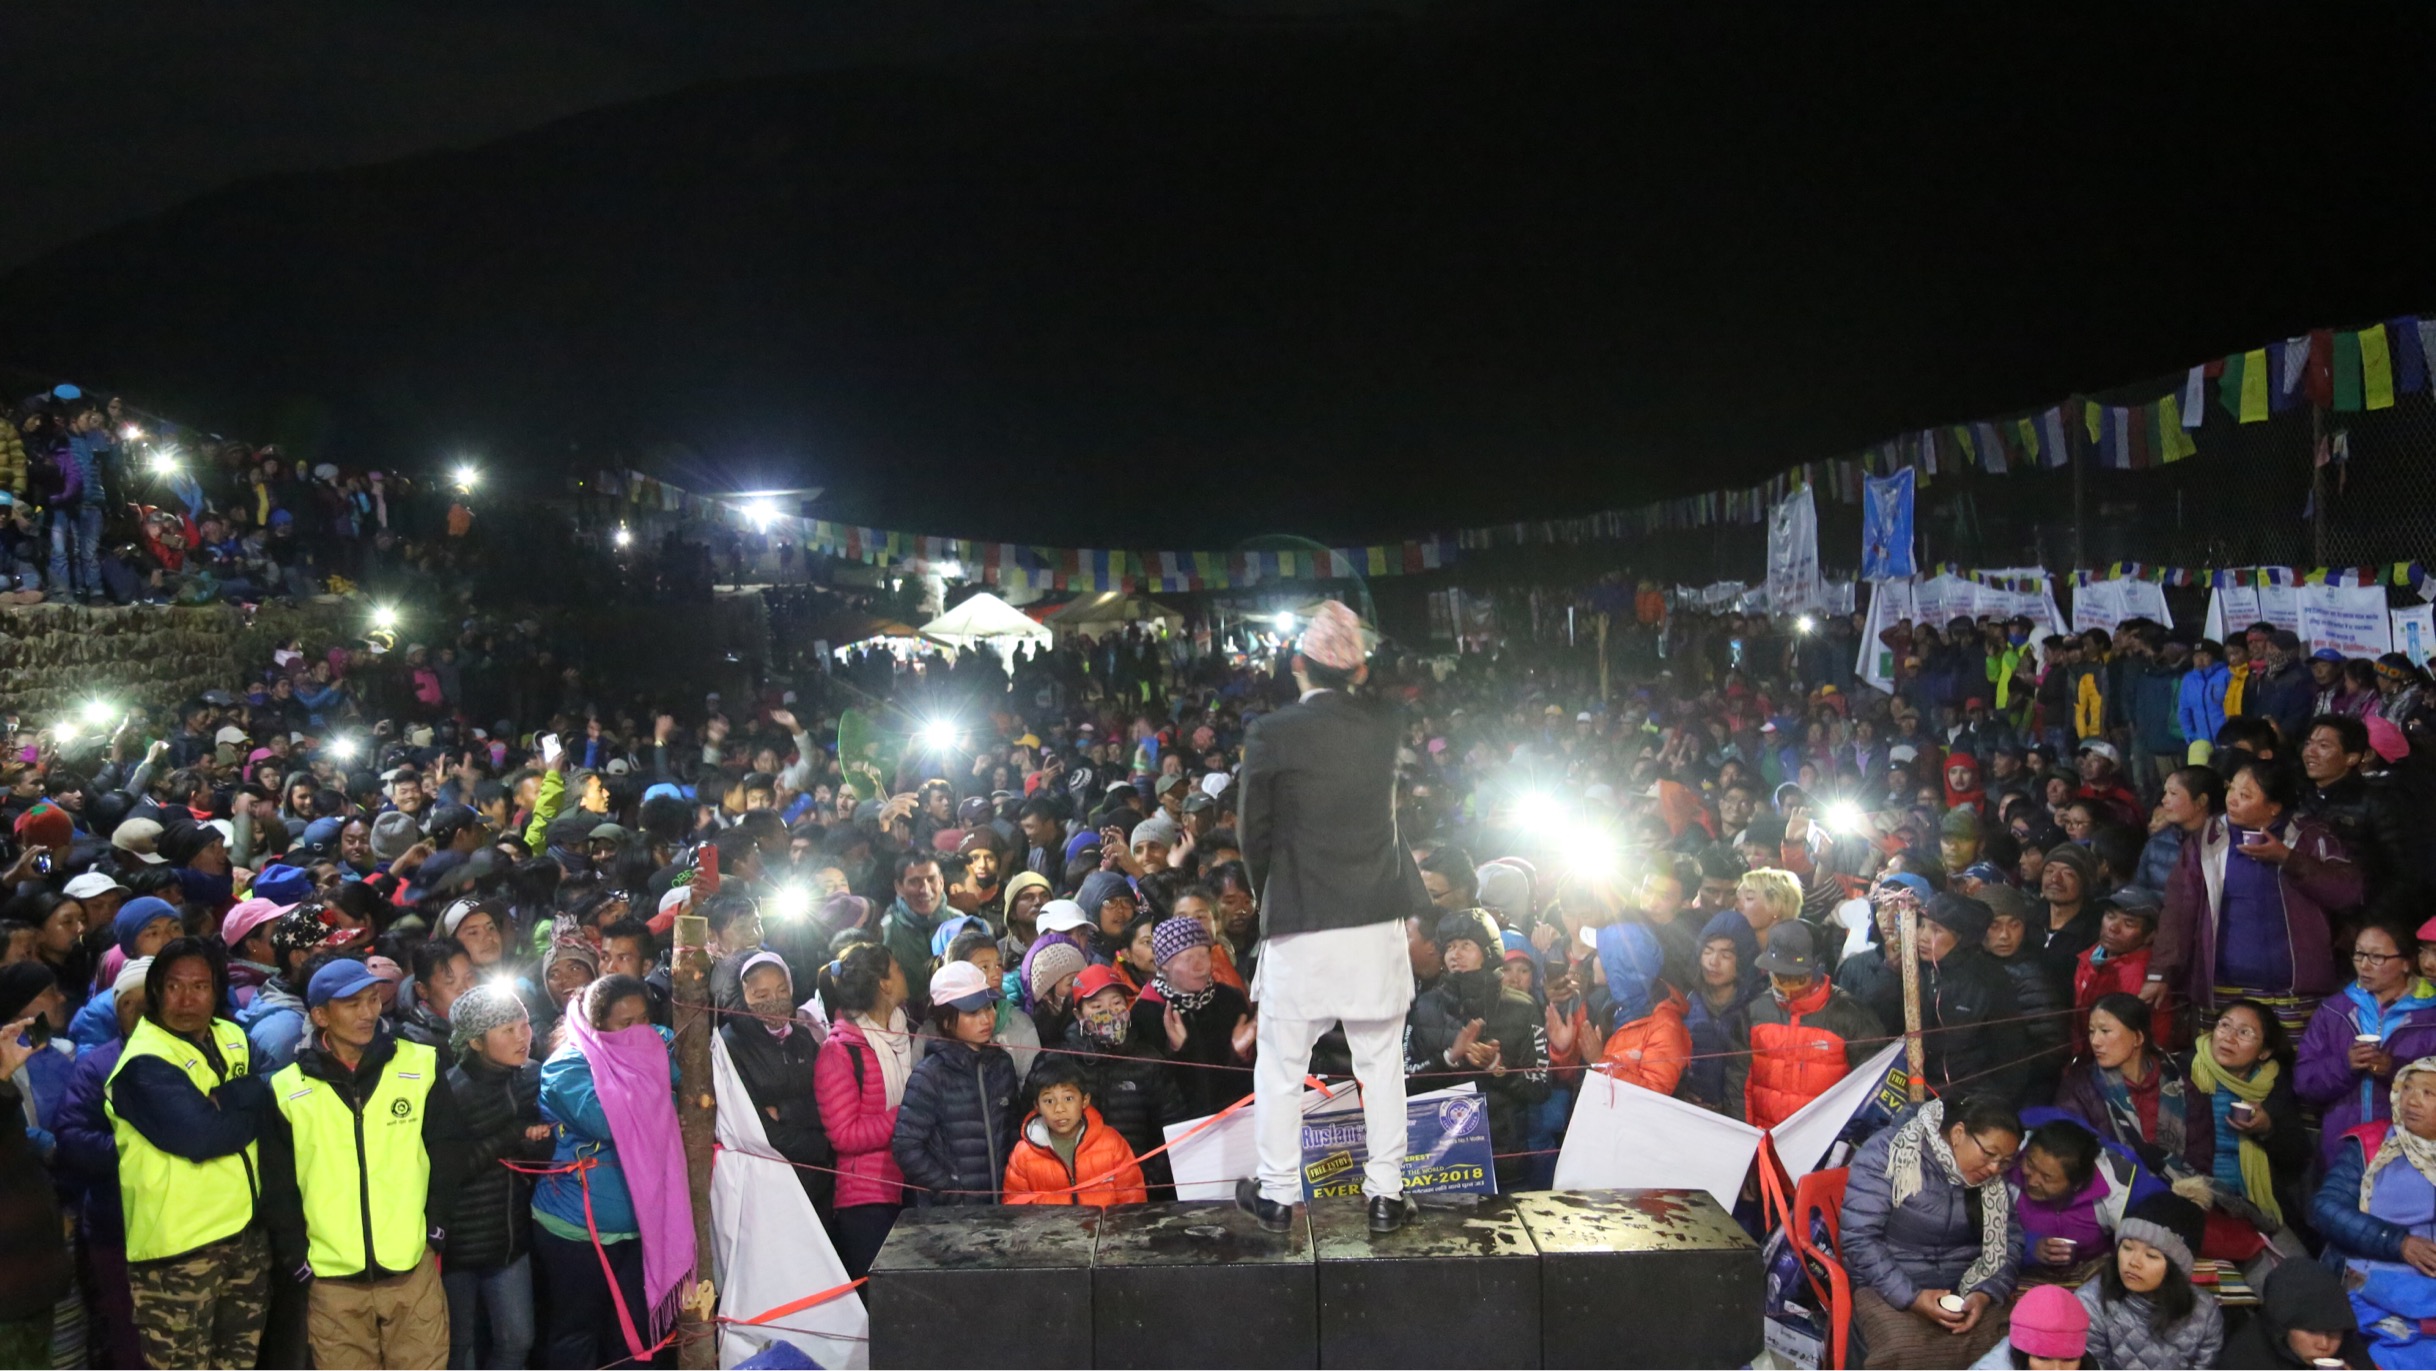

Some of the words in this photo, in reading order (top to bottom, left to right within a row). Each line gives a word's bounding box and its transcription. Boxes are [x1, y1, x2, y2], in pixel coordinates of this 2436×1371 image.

[1531, 1024, 1548, 1054] Air
[1301, 1123, 1358, 1149] Ruslan
[1404, 1153, 1430, 1163] EREST
[1310, 1164, 1327, 1178] FREE
[1422, 1166, 1445, 1174] WORLD
[1313, 1183, 1360, 1199] EVER
